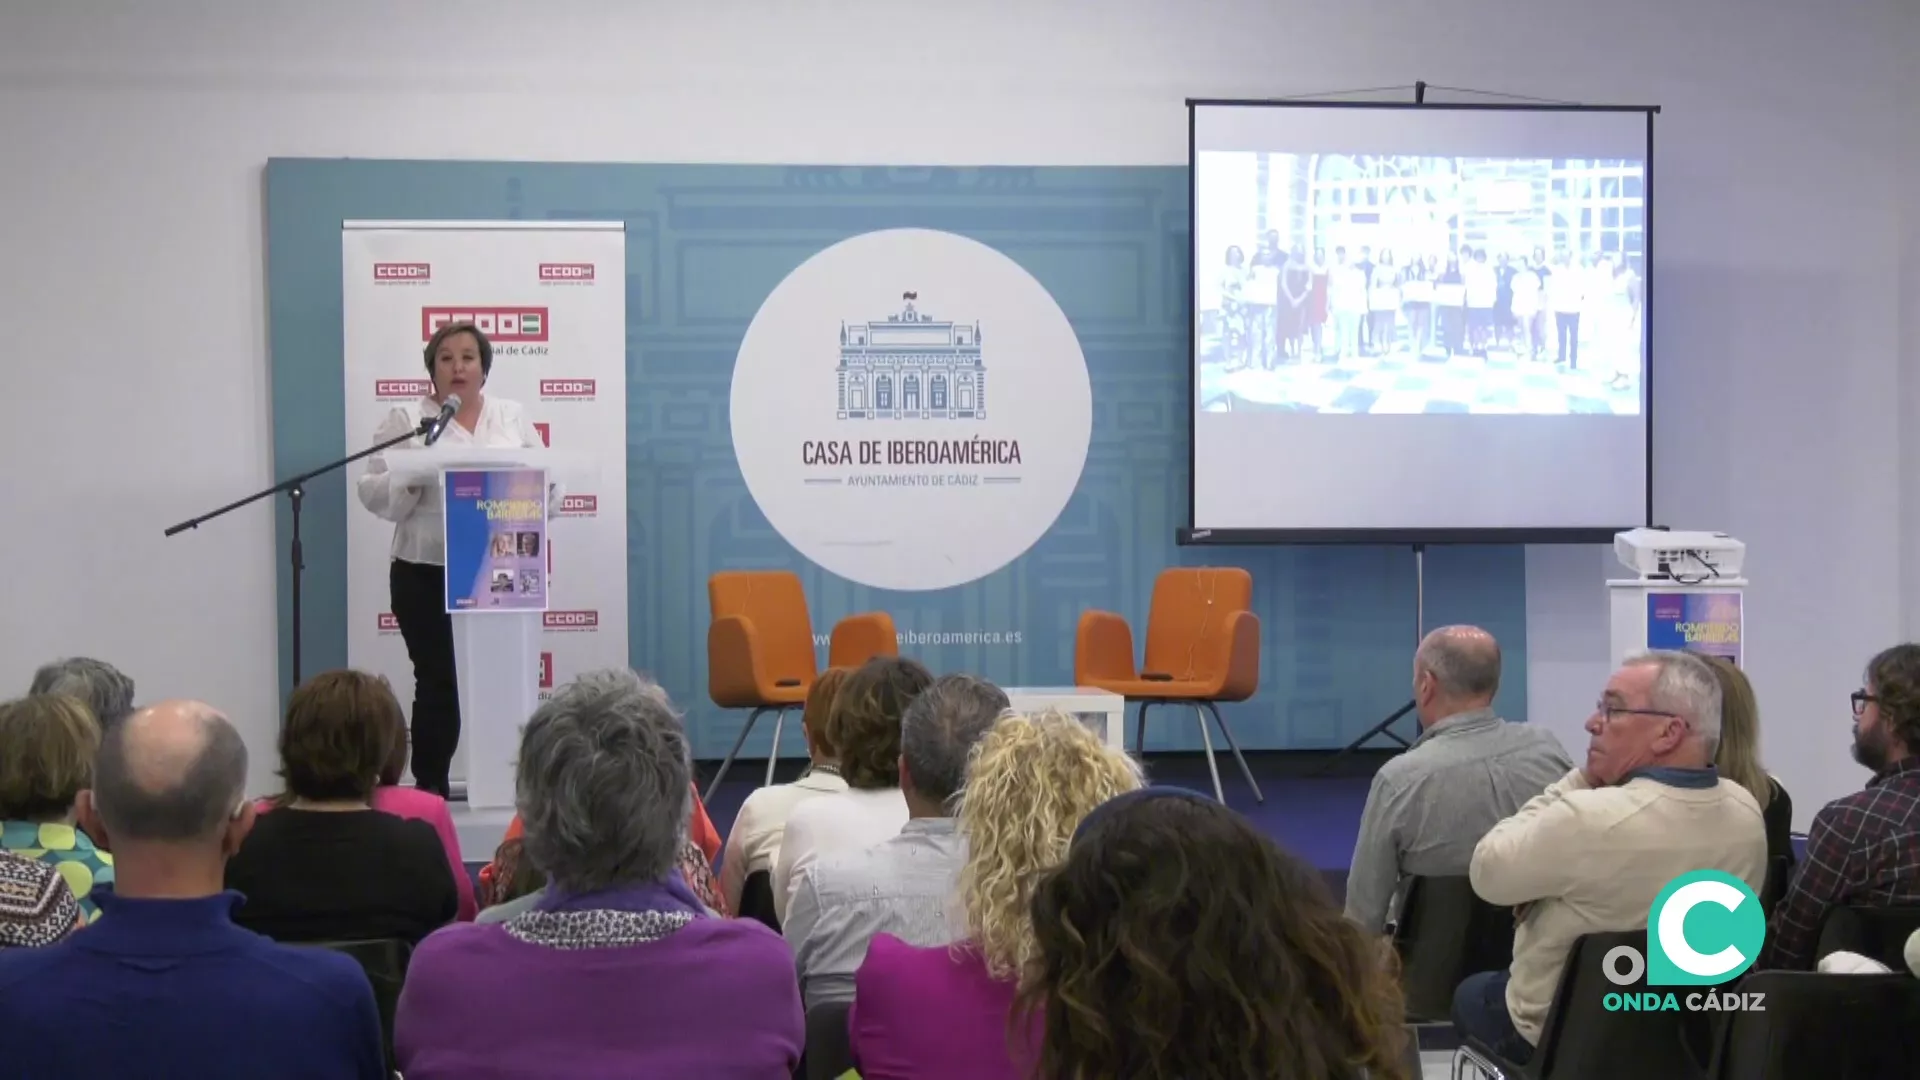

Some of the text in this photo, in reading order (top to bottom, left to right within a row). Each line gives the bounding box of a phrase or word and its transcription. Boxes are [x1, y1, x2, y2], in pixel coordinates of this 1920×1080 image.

[521, 344, 549, 356] Cádiz
[802, 433, 1022, 466] CASA DE IBEROAMÉRICA
[847, 472, 978, 487] AYUNTAMIENTO DE CÁDIZ
